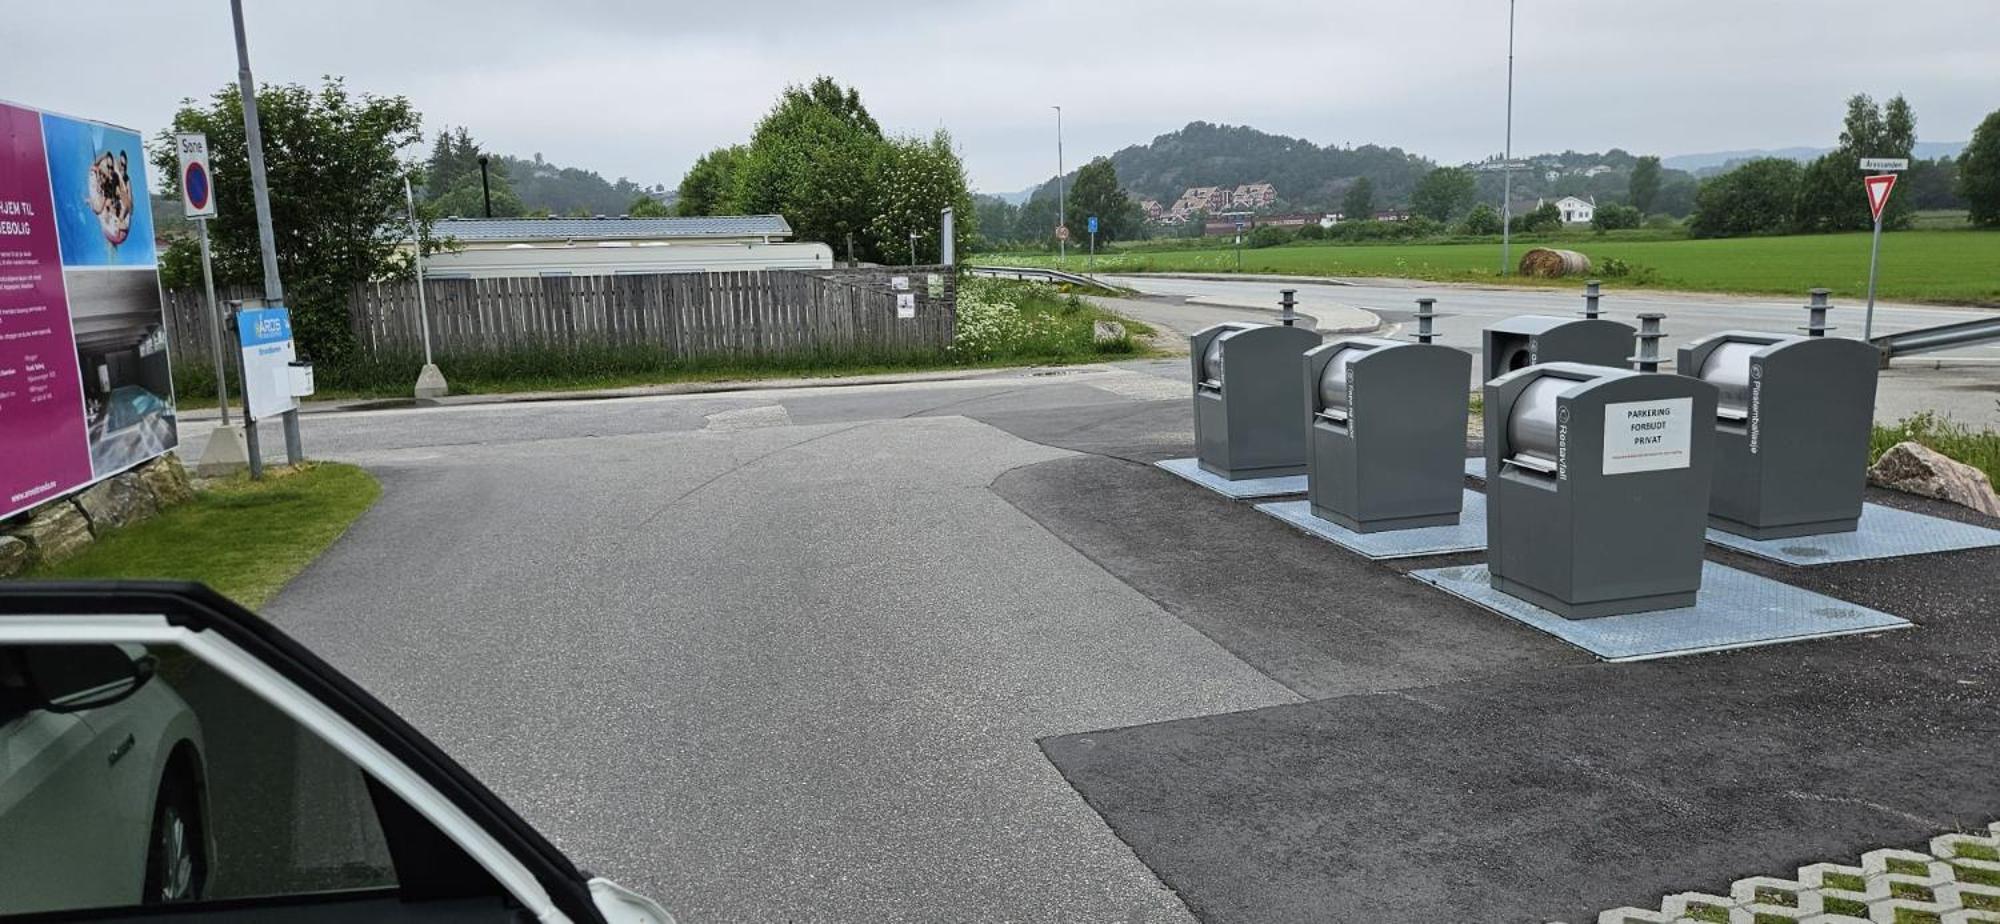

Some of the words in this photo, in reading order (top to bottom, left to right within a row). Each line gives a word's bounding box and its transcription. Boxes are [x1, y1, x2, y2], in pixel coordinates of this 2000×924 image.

[181, 139, 203, 153] Sone
[1627, 407, 1671, 419] PARKERING
[1630, 421, 1666, 432] FORBUDT
[1634, 435, 1662, 445] PRIVAT
[1559, 424, 1568, 481] Restavfall
